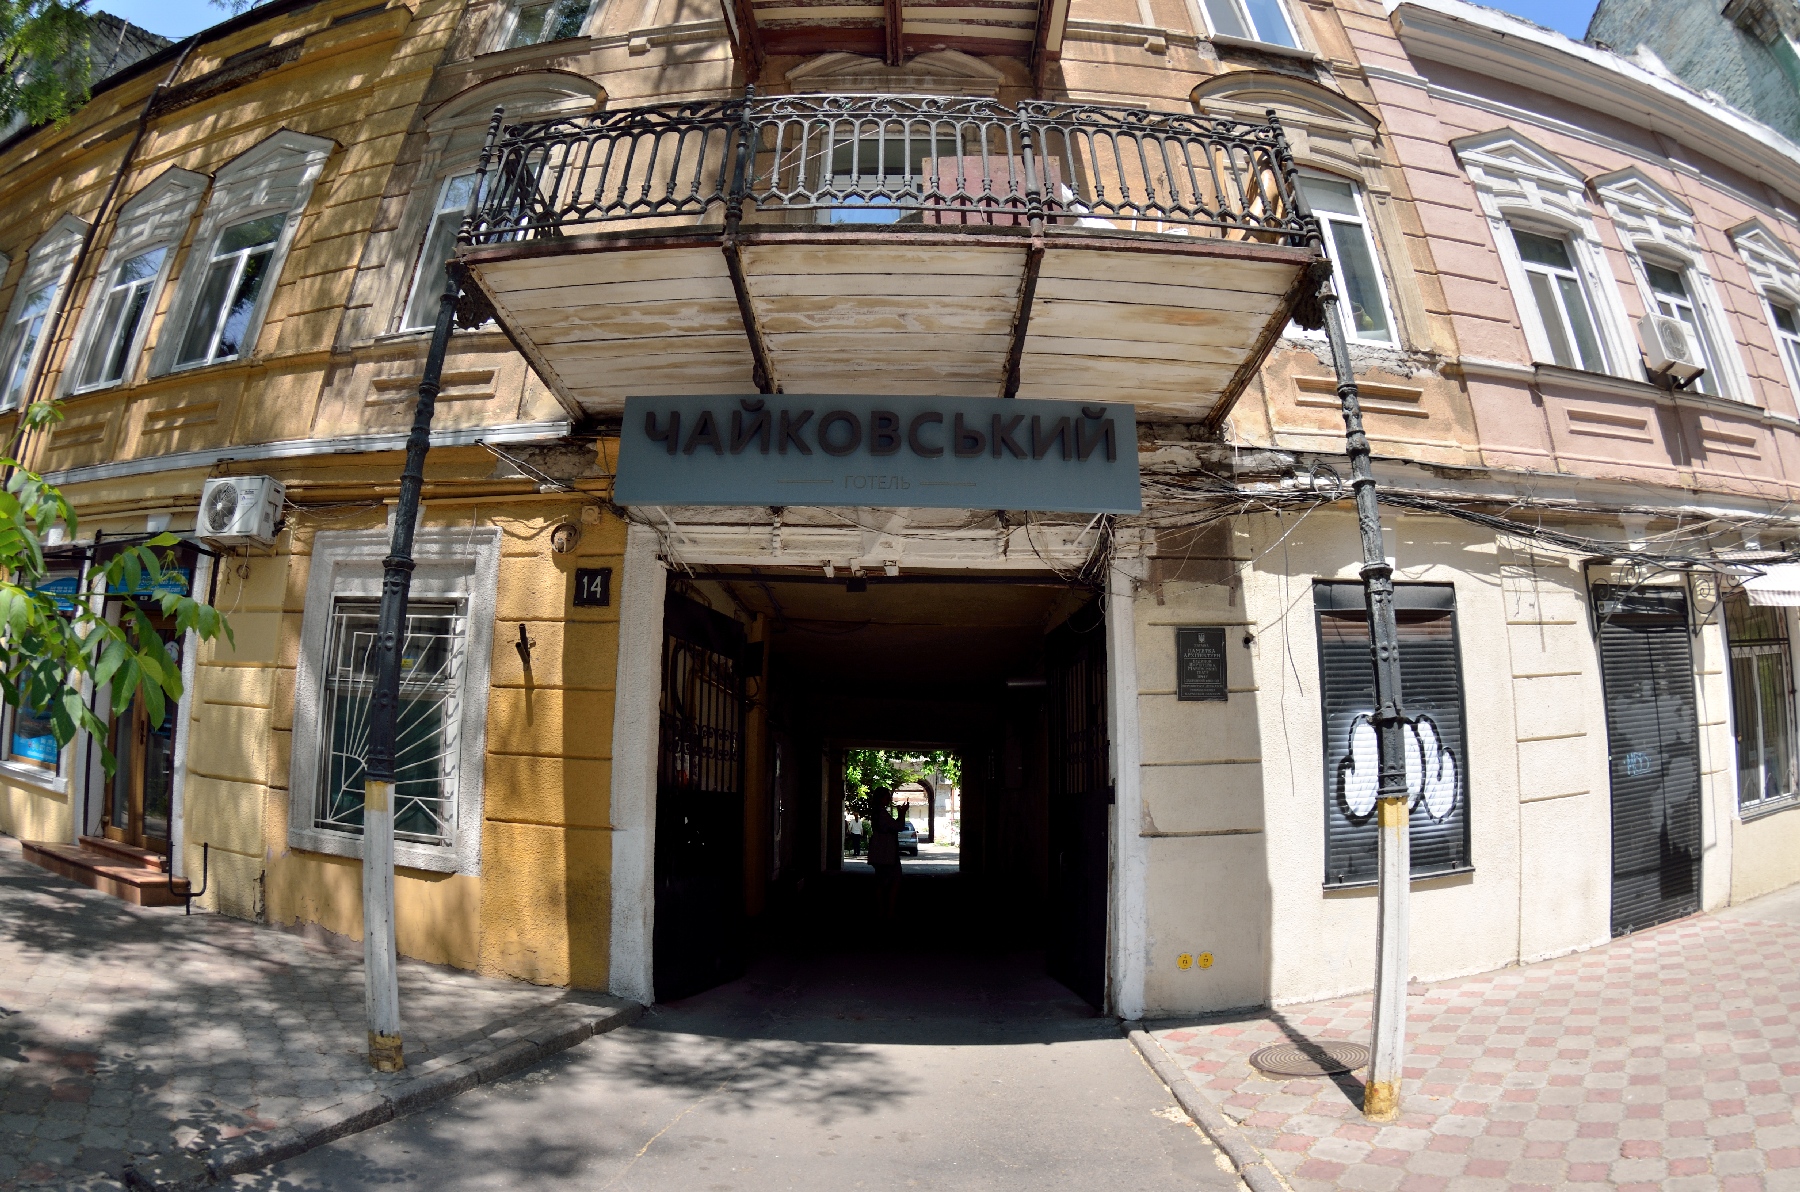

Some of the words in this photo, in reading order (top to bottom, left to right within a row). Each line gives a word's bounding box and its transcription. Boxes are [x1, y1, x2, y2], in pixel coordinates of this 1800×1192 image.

[644, 398, 1117, 463] ЧАЙКОВСЬКИЙ
[843, 475, 911, 490] ГОТЕЛЬ
[582, 575, 602, 599] 14
